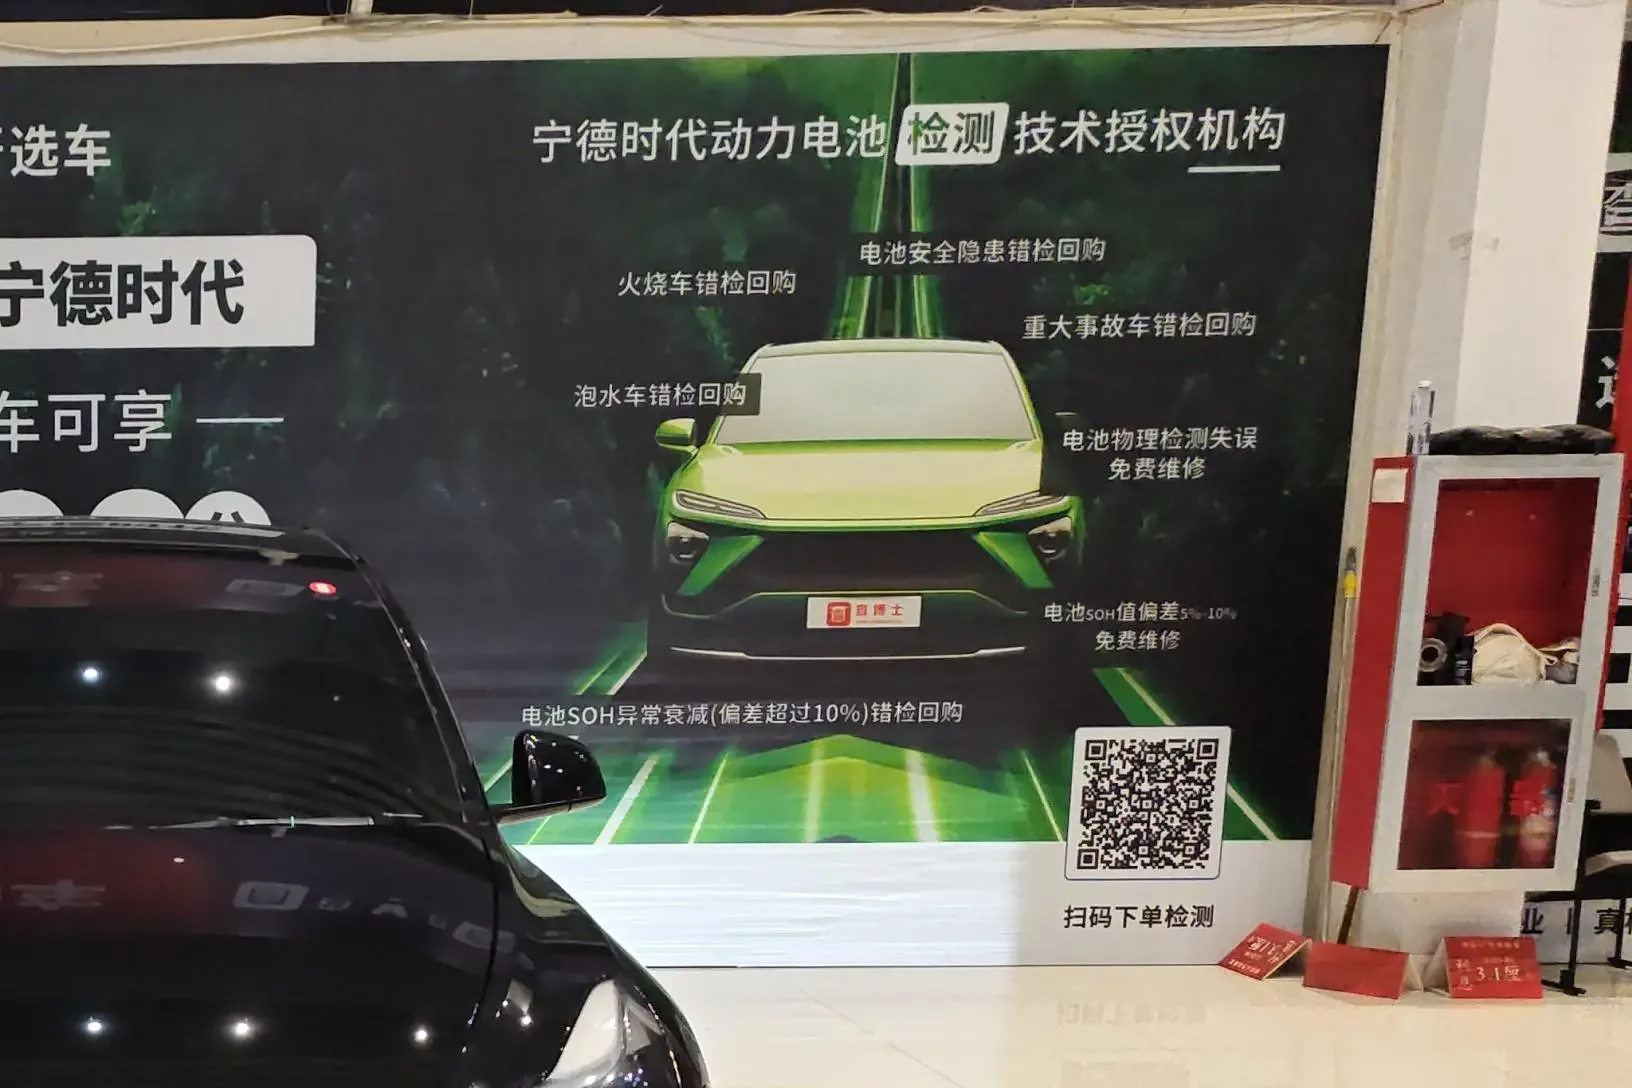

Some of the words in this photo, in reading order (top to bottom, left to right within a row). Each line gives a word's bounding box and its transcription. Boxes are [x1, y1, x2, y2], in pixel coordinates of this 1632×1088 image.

[532, 113, 886, 163] 宁德时代动力电池
[906, 110, 995, 156] 检测
[1012, 105, 1286, 155] 技术授权机构
[860, 237, 1106, 266] 电池安全隐患错检回购
[617, 269, 797, 297] 火烧车错检回购
[1022, 311, 1257, 340] 重大事故车错检回购
[574, 381, 747, 408] 泡水车错检回购
[1062, 426, 1258, 452] 电池物理检测失误
[1108, 456, 1206, 481] 免费维修
[1094, 629, 1181, 651] 免费维修
[1063, 904, 1216, 929] 扫码下单检测
